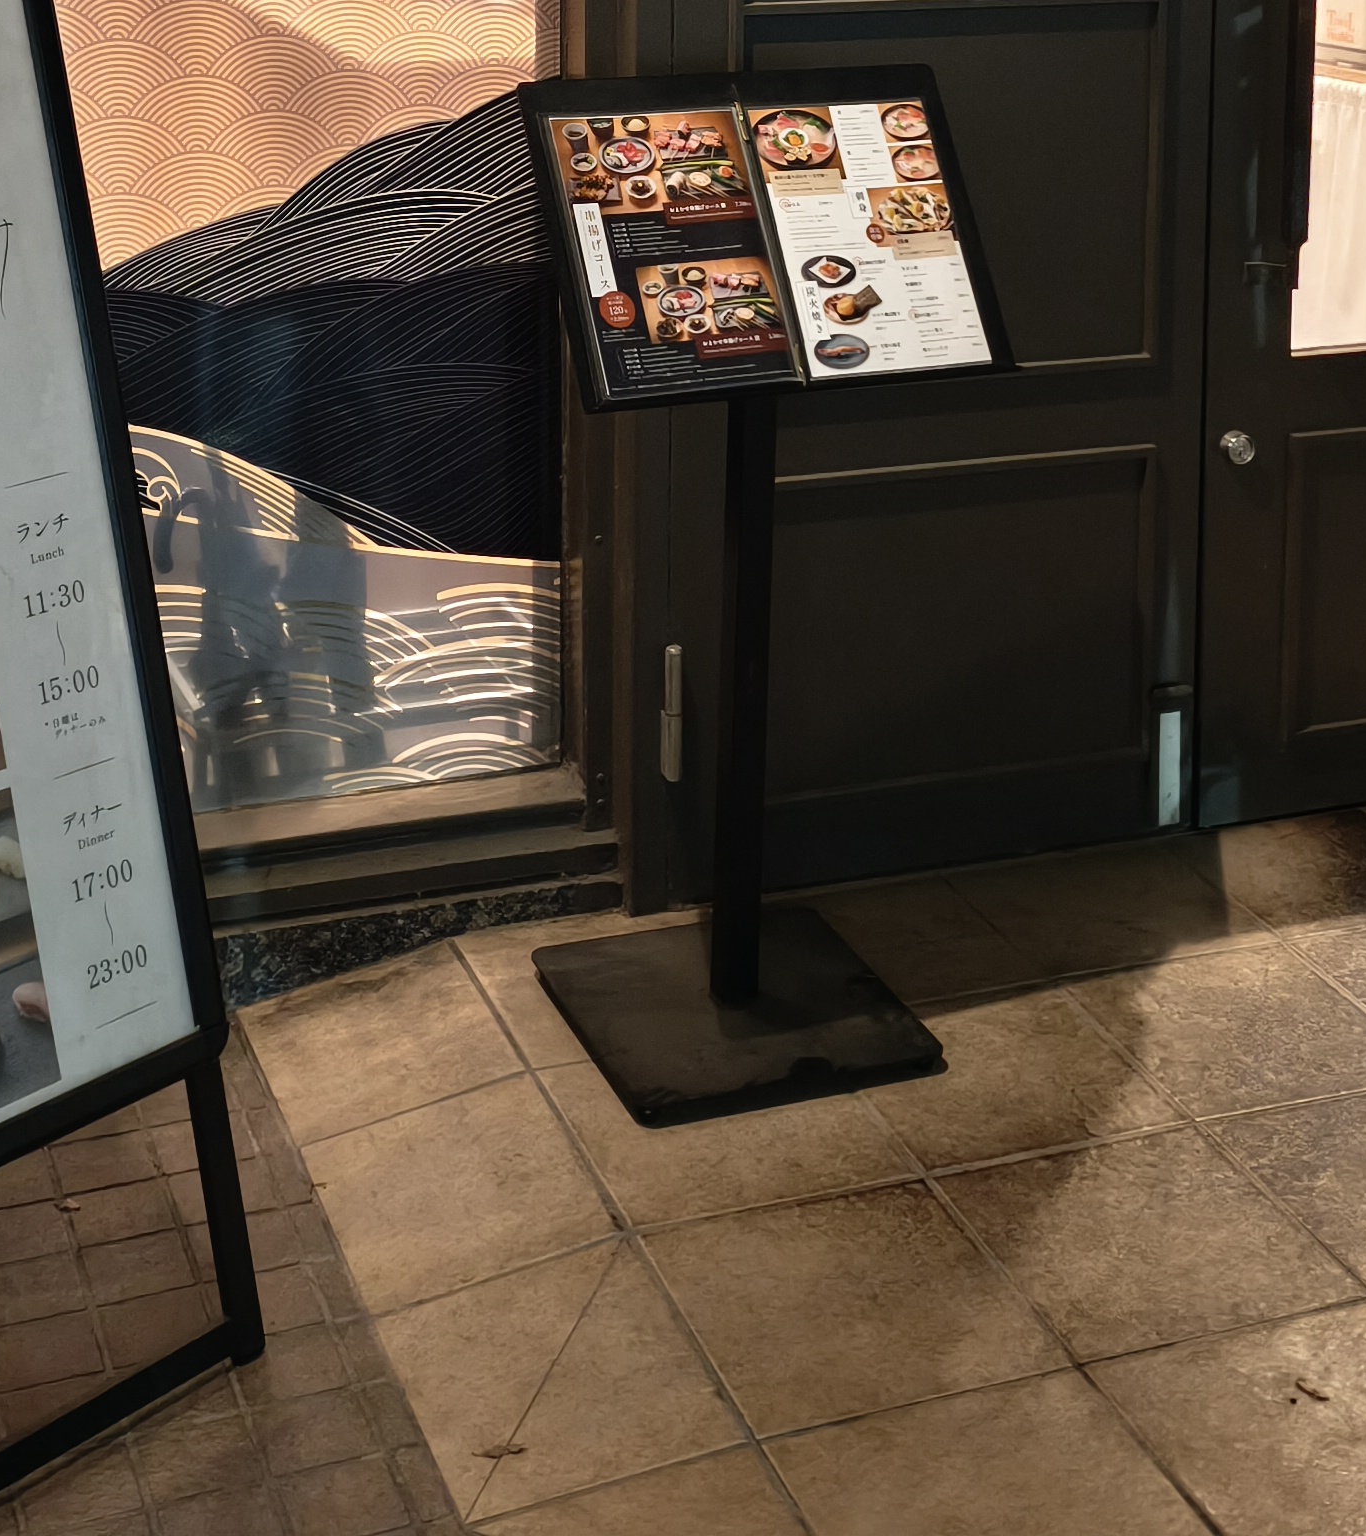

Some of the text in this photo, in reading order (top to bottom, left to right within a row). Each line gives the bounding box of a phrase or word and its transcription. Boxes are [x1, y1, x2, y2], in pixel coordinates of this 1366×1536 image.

[585, 210, 611, 289] 串揚げコース
[16, 513, 70, 544] ランチ
[30, 546, 65, 565] Lunch
[24, 579, 86, 618] 11:30
[39, 665, 100, 705] 15:00
[62, 802, 123, 835] ディナー
[77, 828, 115, 851] Dinner
[72, 859, 134, 903] 17:00
[88, 944, 148, 989] 23:00
